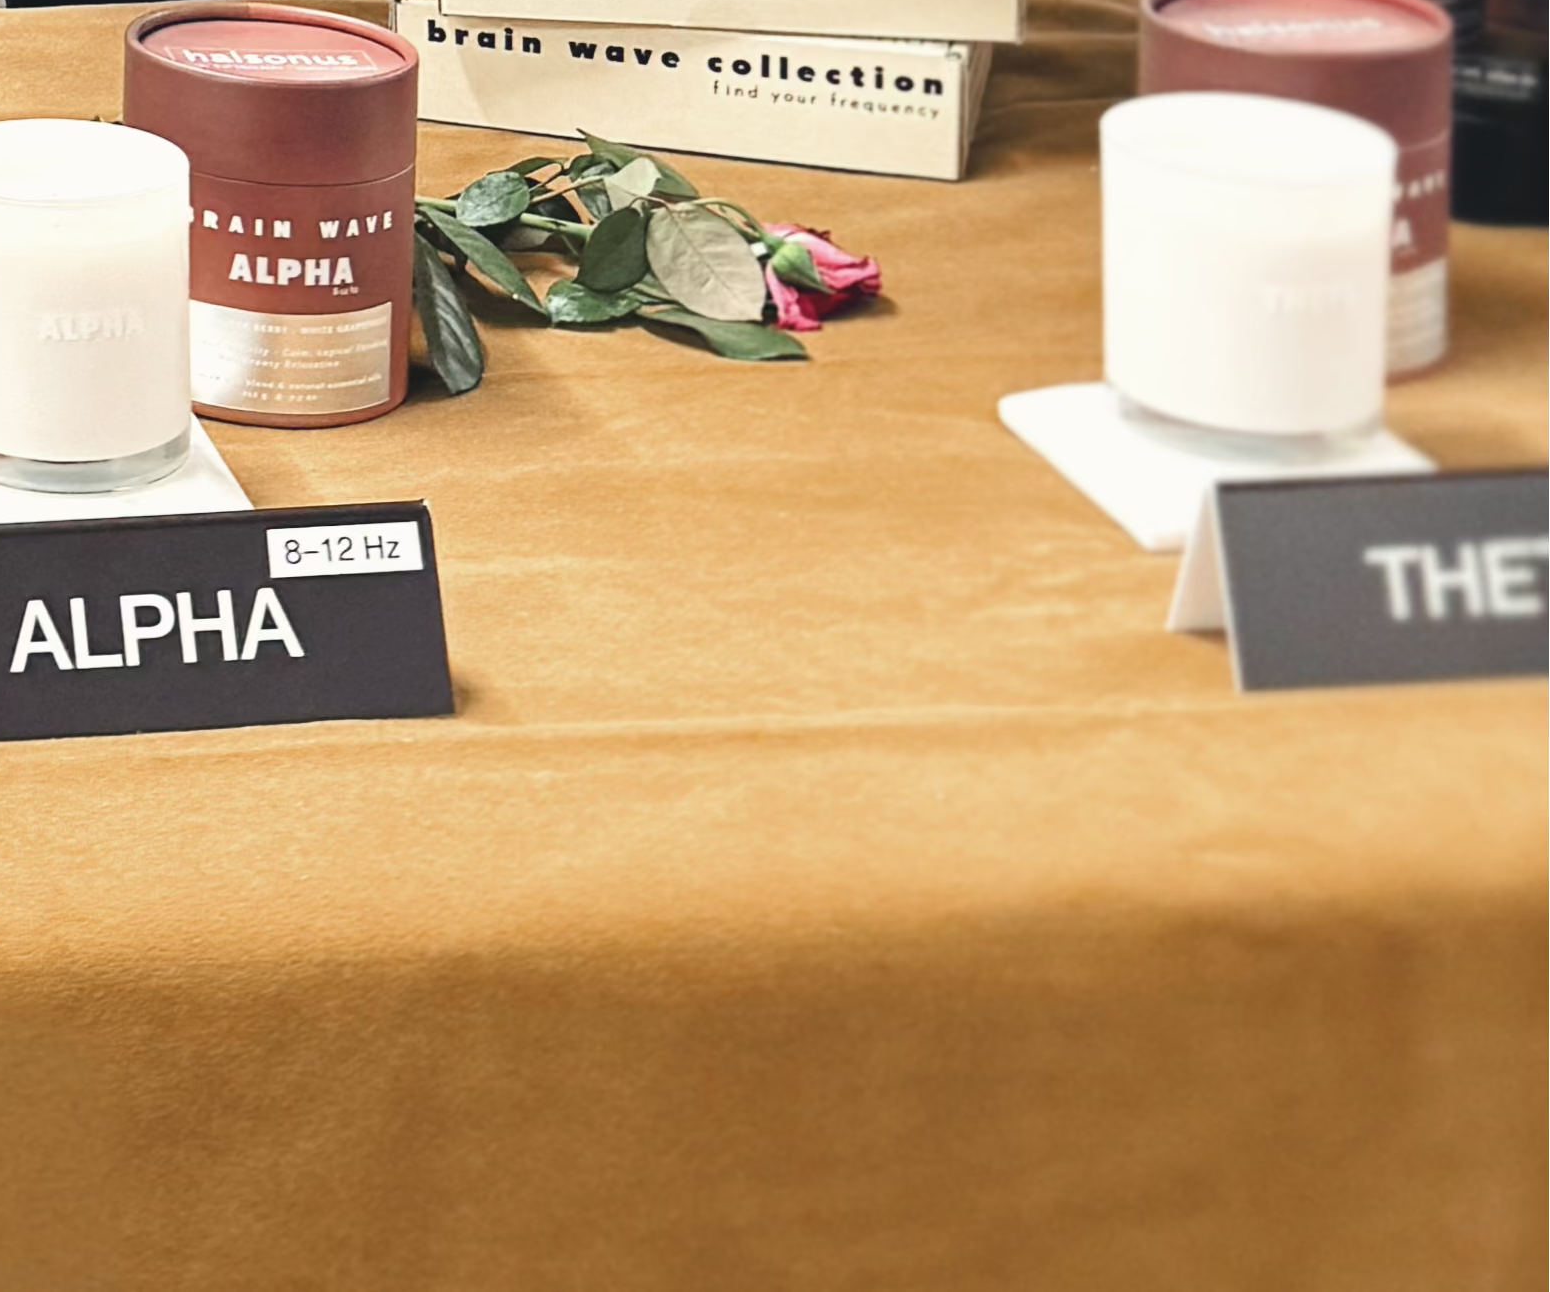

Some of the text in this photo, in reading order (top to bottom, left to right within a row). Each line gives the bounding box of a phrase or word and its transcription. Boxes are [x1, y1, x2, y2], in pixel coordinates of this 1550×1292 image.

[181, 48, 360, 67] halsonus
[426, 19, 946, 98] brain wave collection
[711, 79, 942, 122] find your frequency
[318, 210, 394, 240] WAVE
[228, 252, 354, 287] ALPHA
[364, 534, 401, 561] Hz
[10, 587, 305, 673] ALPHA
